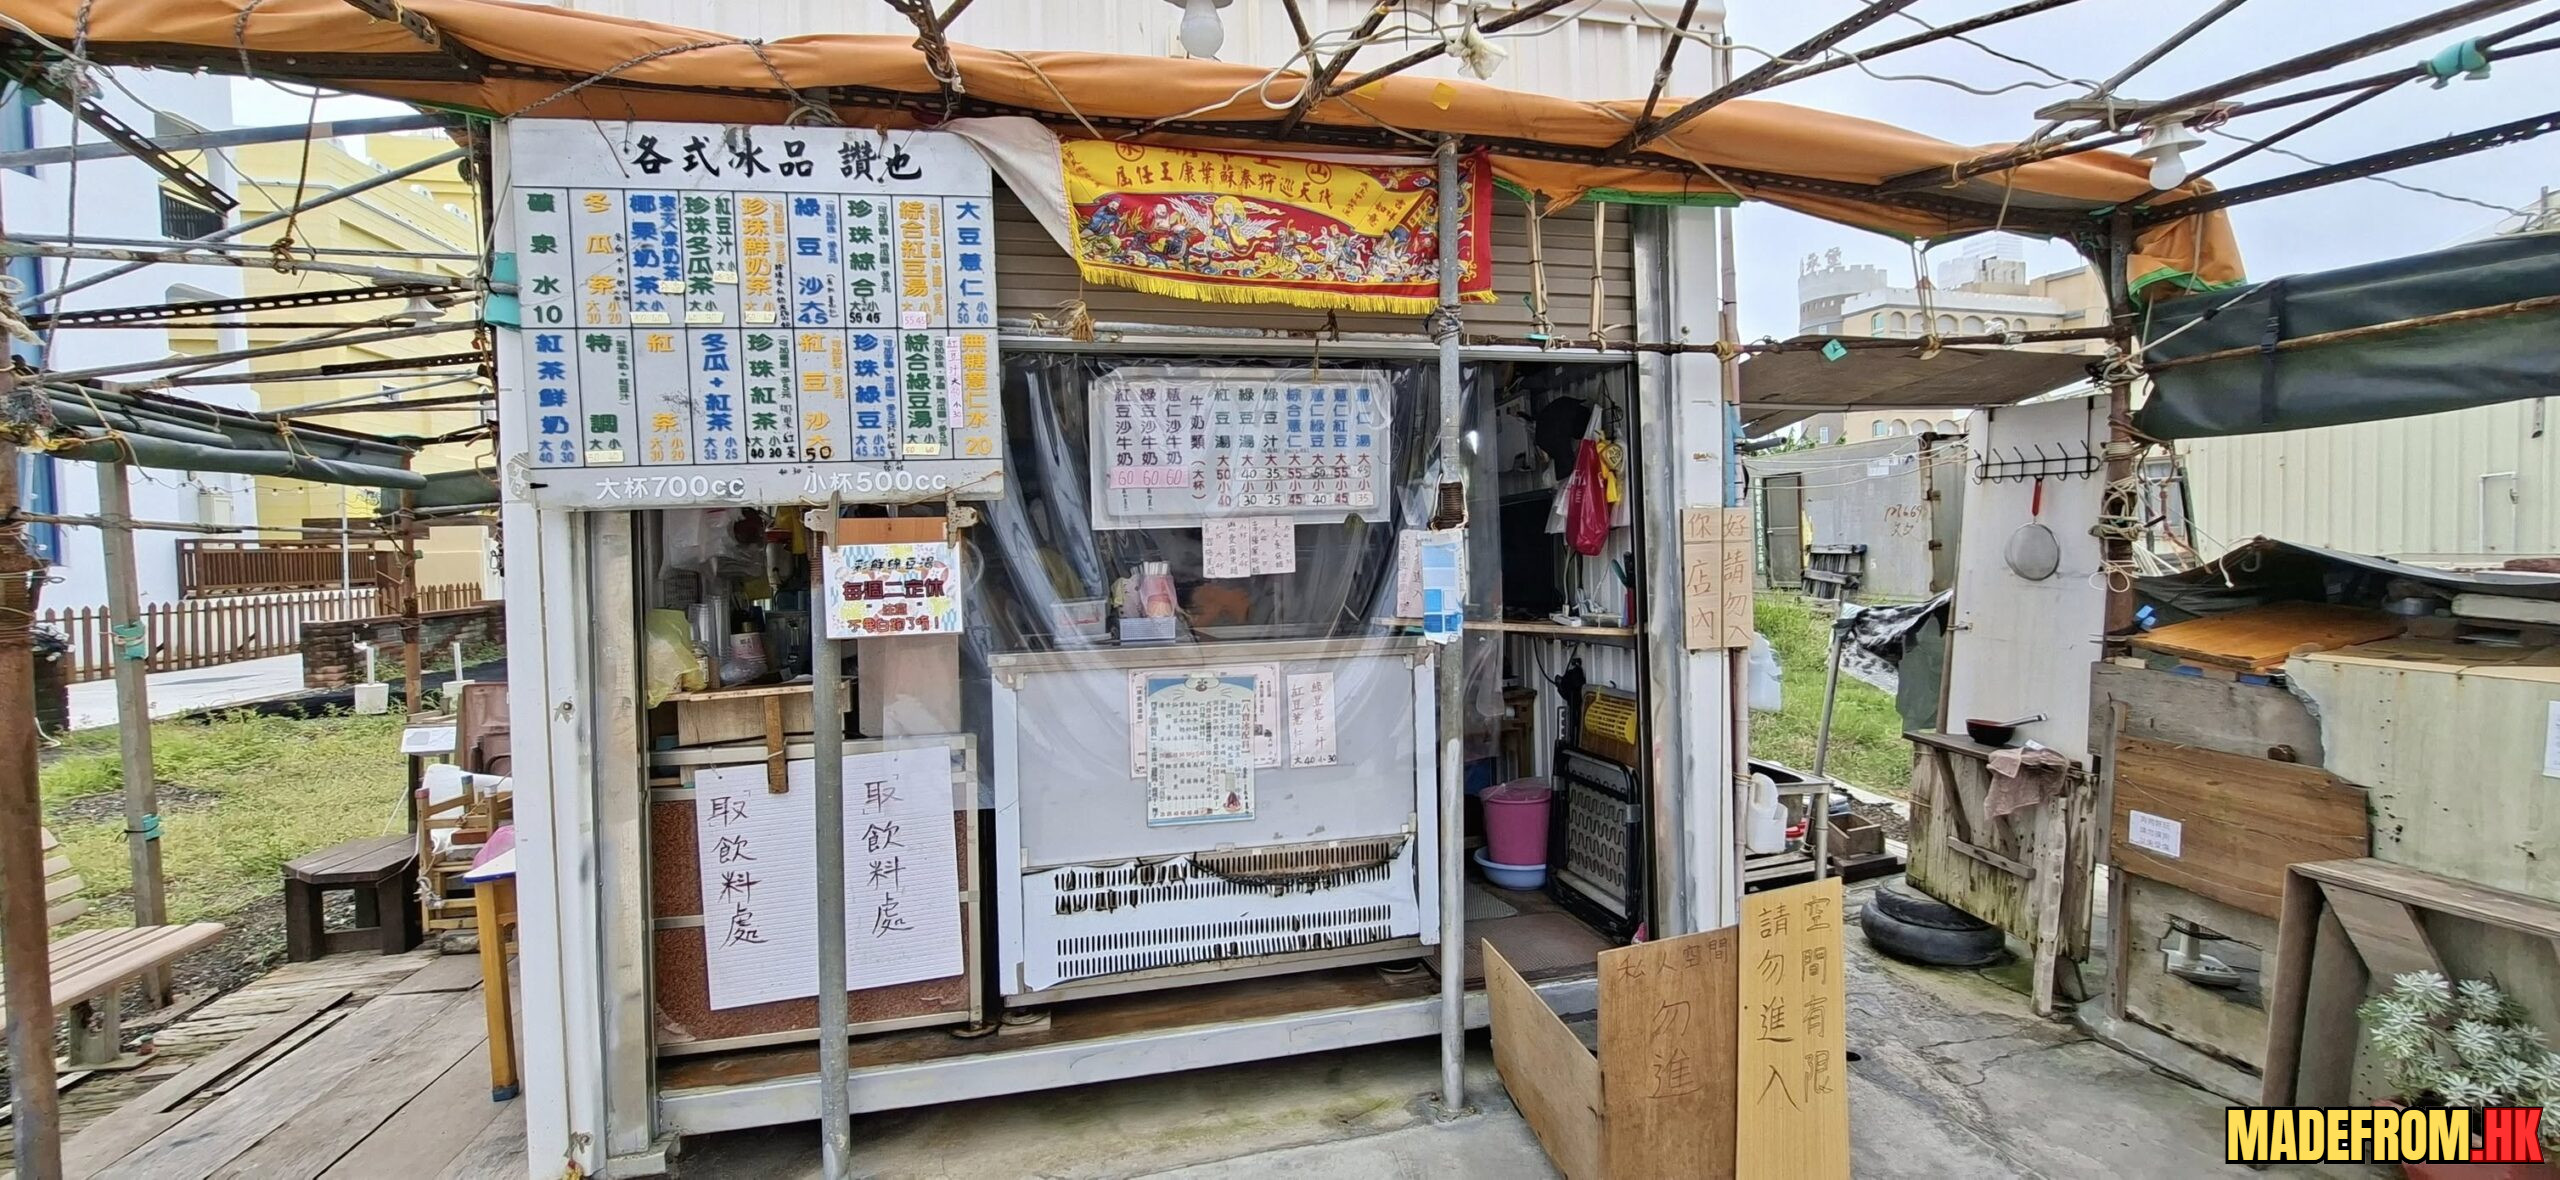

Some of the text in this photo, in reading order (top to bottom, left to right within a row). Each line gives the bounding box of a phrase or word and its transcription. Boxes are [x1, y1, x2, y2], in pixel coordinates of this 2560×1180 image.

[631, 134, 922, 181] 各式冰品 讚也
[715, 196, 733, 256] 紅豆汁
[583, 191, 617, 295] 冬瓜茶
[629, 193, 660, 295] 椰果奶茶
[683, 196, 715, 295] 珍珠冬瓜茶
[741, 197, 773, 296] 珍珠鮮奶茶
[794, 197, 824, 295] 綠豆沙
[847, 199, 877, 297] 珍珠綜合
[899, 200, 928, 297] 綜合紅豆湯
[956, 201, 984, 297] 大豆薏仁
[527, 193, 563, 324] 礦泉水 10
[797, 301, 829, 325] 大 45
[957, 301, 988, 312] 大 小
[957, 313, 988, 324] 50 40
[535, 333, 570, 434] 紅茶鮮奶
[647, 333, 683, 433] 紅茶
[701, 333, 732, 432] 冬瓜+紅茶
[747, 333, 778, 430] 珍珠紅茶
[800, 333, 831, 431] 紅豆沙
[853, 333, 881, 429] 珍珠綠豆
[904, 333, 932, 429] 綜合綠豆湯
[1190, 395, 1205, 449] 牛奶類
[1262, 388, 1278, 447] 綠豆汁
[538, 440, 574, 451] 大 小
[589, 438, 622, 450] 大 小
[703, 437, 738, 448] 大 小
[751, 436, 781, 447] 大 小
[856, 434, 884, 445] 大 小
[907, 433, 935, 444] 大 小
[964, 437, 992, 456] 20
[1115, 388, 1134, 486] 紅豆沙牛奶 60
[1140, 388, 1159, 486] 綠豆沙牛奶 60
[1214, 388, 1232, 506] 紅豆湯 大 50 小 40
[1238, 388, 1257, 505] 綠豆湯 大 40 小 30
[538, 452, 575, 463] 40 30
[704, 449, 738, 460] 35 25
[769, 448, 782, 458] 30
[805, 446, 832, 462] 50
[855, 446, 885, 457] 45 35
[1265, 454, 1277, 466] 大
[1289, 454, 1301, 465] 大
[1312, 454, 1325, 465] 大
[1335, 453, 1347, 465] 大
[1358, 453, 1370, 464] 大
[803, 471, 947, 494] 小杯500cc
[1166, 469, 1182, 485] 60
[1266, 468, 1280, 478] 35
[1288, 468, 1302, 479] 55
[1334, 467, 1348, 478] 55
[595, 475, 745, 500] 大杯700cc
[1265, 480, 1278, 491] 小
[1289, 480, 1301, 491] 小
[1312, 480, 1325, 491] 小
[1335, 479, 1347, 491] 小
[1358, 479, 1371, 490] 小
[1267, 495, 1281, 505] 25
[1288, 494, 1303, 504] 45
[1312, 495, 1326, 506] 40
[1334, 493, 1348, 504] 45
[842, 578, 945, 601] 每週二定休
[1687, 559, 1715, 640] 店內
[1723, 550, 1752, 641] 請勿入
[1304, 756, 1315, 764] 40
[1328, 754, 1337, 763] 30
[1616, 937, 1732, 983] 私人空間
[1756, 902, 1801, 1112] 請勿進入
[1800, 896, 1834, 1103] 空間有限
[1648, 1000, 1705, 1100] 勿進
